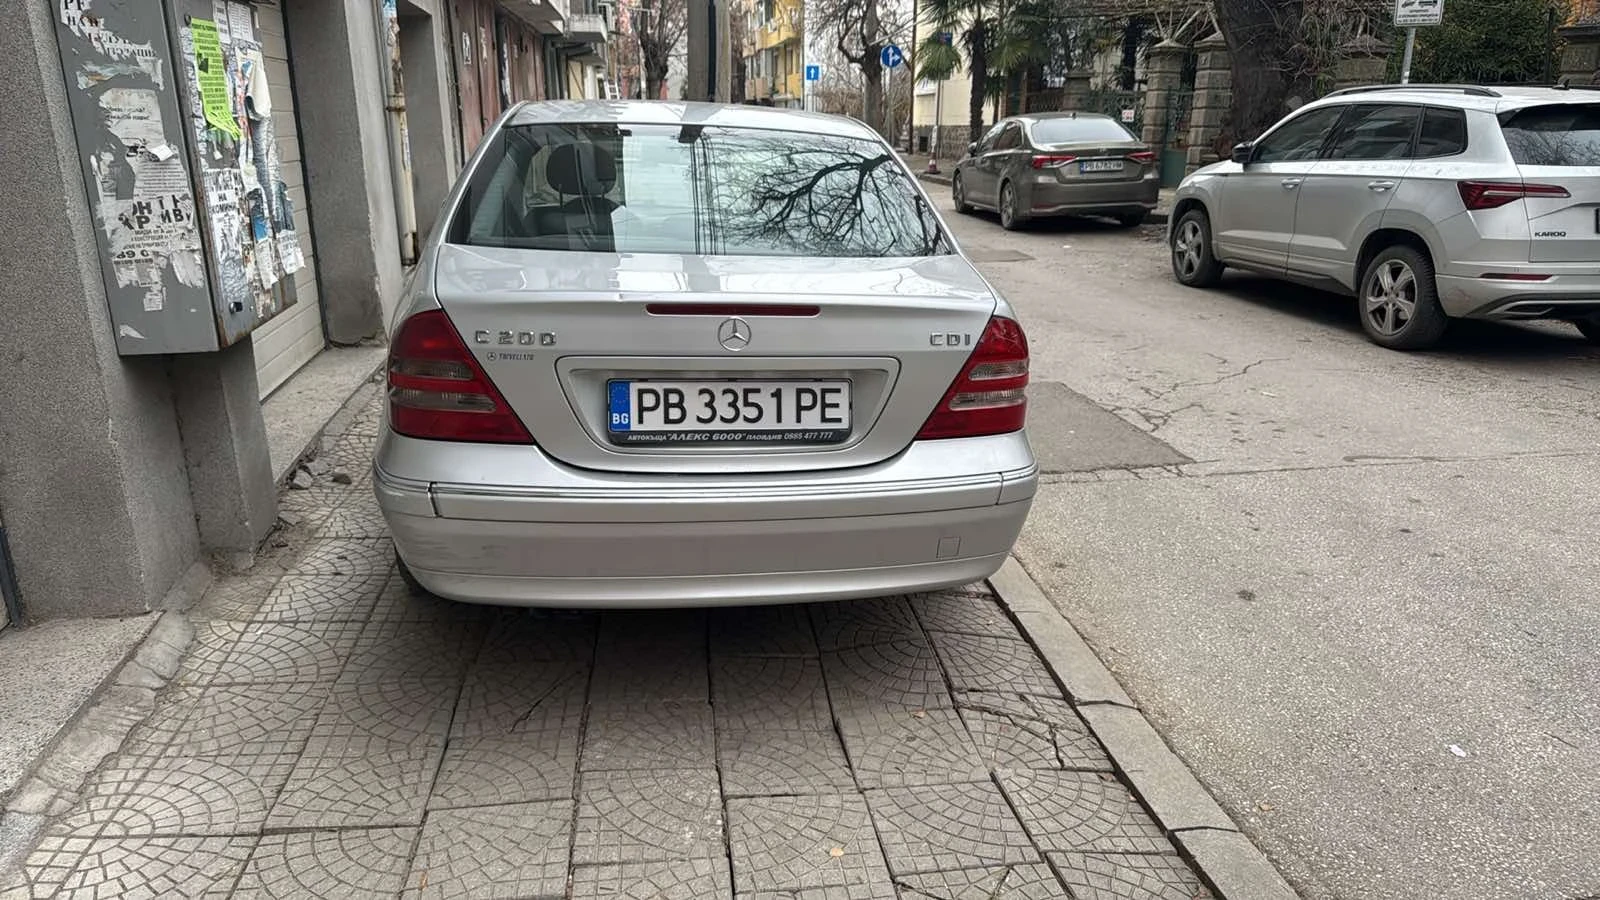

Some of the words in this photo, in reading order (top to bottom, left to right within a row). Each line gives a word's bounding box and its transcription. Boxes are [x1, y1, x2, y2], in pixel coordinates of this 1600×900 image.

[475, 329, 491, 344] C
[498, 330, 557, 346] 200
[929, 332, 972, 346] CDI
[637, 387, 687, 425] PB
[696, 387, 783, 425] 3351
[795, 387, 843, 424] PE
[612, 413, 629, 425] BG
[627, 434, 667, 442] АВТОКЪЩА
[819, 431, 833, 440] 777
